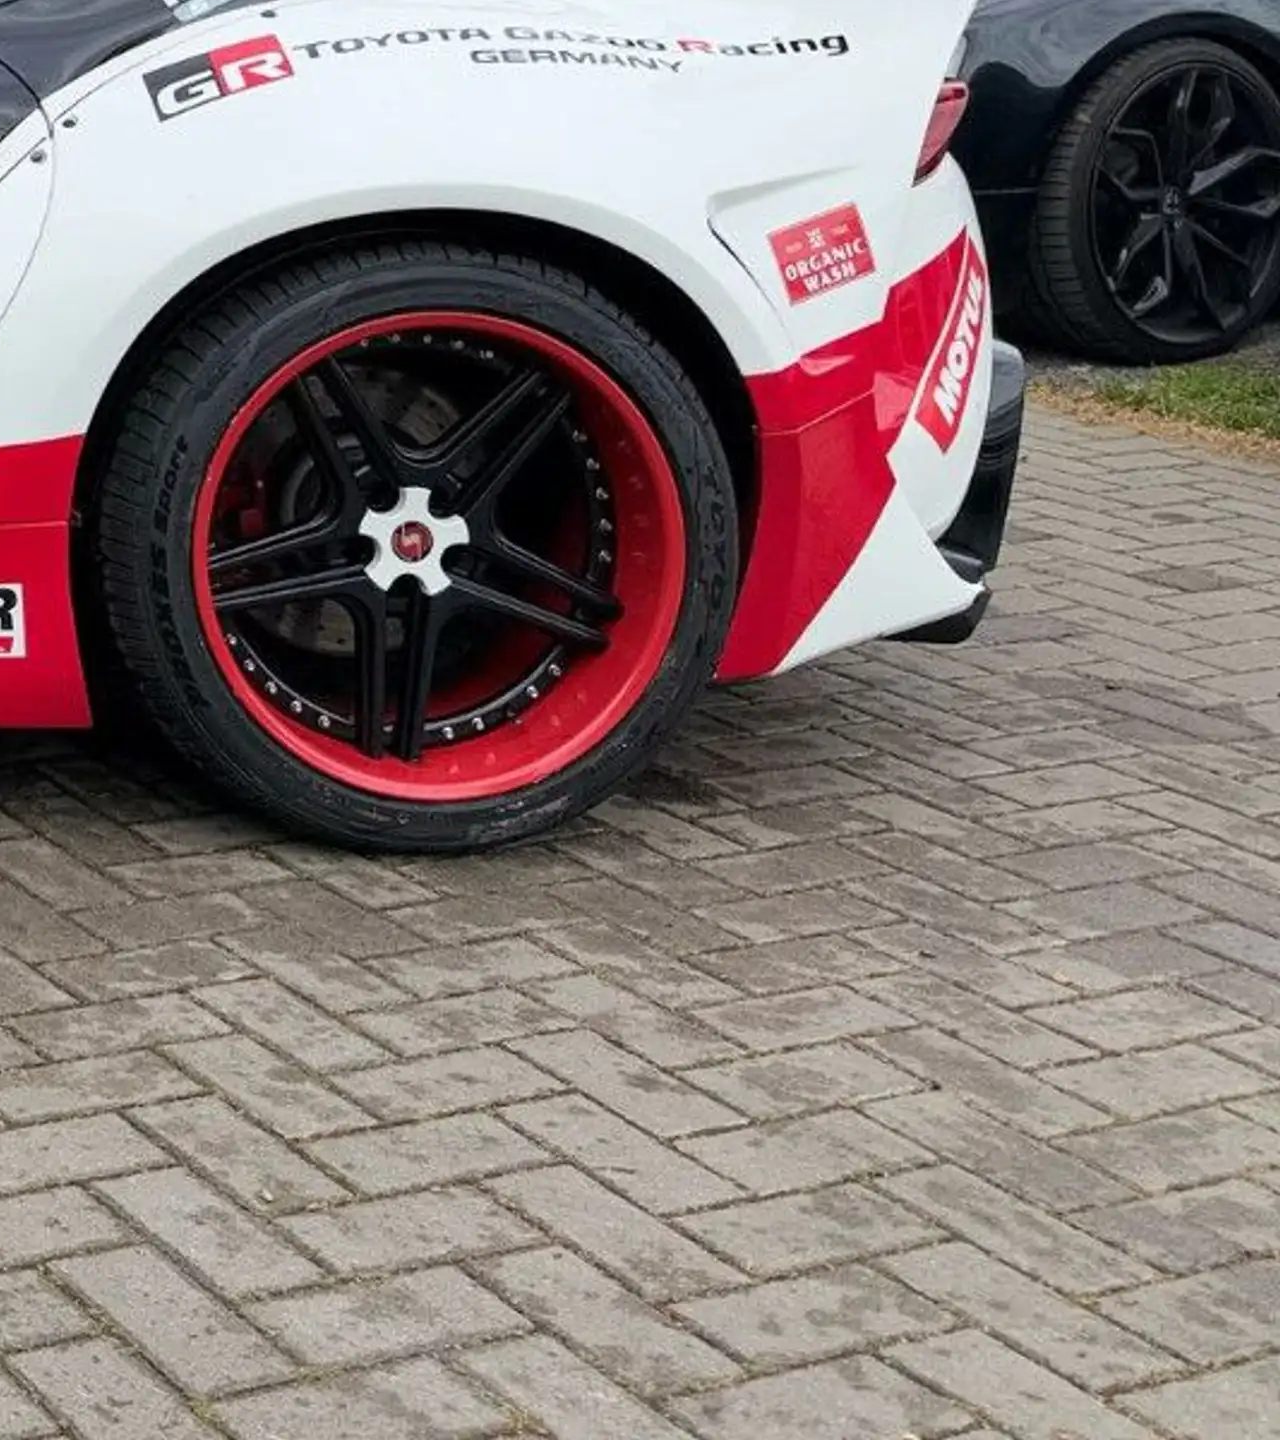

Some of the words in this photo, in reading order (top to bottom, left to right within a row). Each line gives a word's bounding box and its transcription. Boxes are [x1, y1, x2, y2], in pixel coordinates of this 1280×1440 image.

[154, 50, 290, 115] GR
[293, 27, 492, 59] TOYOTA
[676, 32, 850, 56] Racing
[470, 48, 683, 74] GERMANY
[784, 239, 866, 281] ORGANIC
[802, 263, 857, 293] WASH
